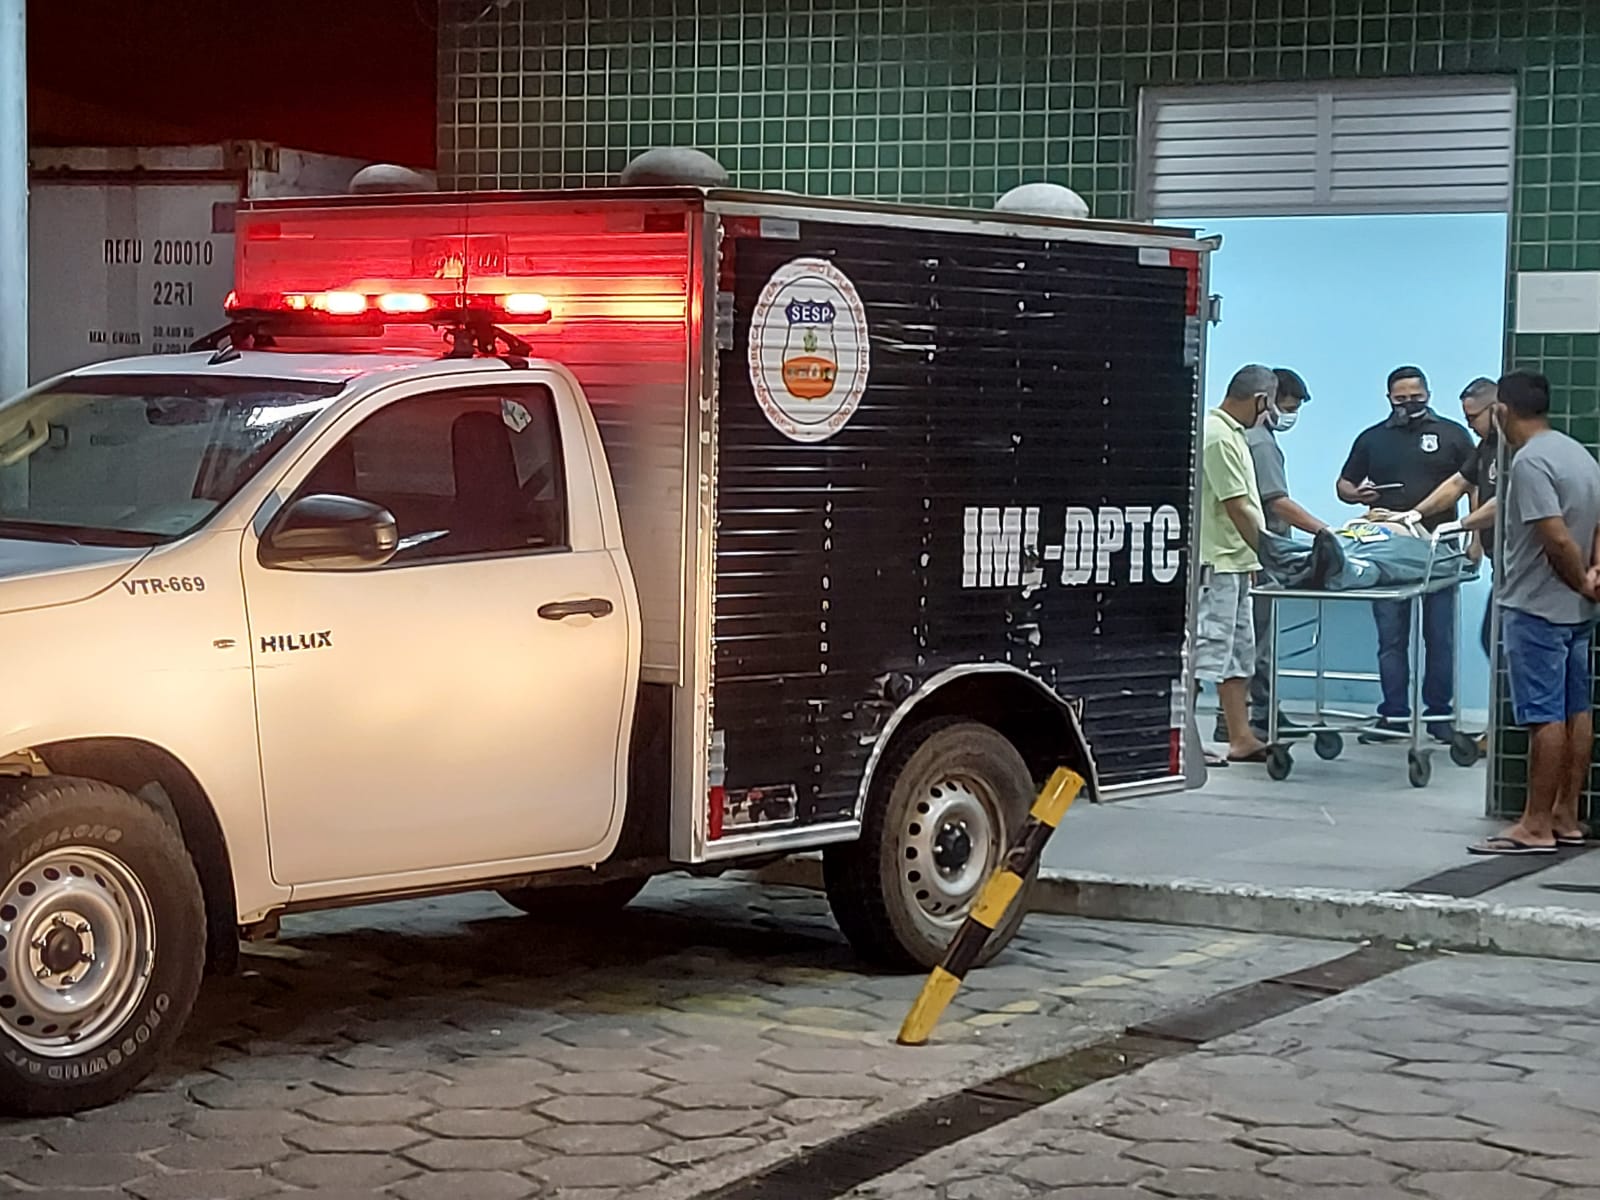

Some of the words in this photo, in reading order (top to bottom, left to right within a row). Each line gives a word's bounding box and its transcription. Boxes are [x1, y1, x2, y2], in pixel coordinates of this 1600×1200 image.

[104, 240, 142, 264] REFU
[154, 240, 213, 265] 200010
[153, 282, 193, 305] 22R1
[791, 306, 832, 322] SESP
[962, 505, 1181, 587] IML-DPTC
[122, 576, 206, 596] VTR-669
[260, 630, 333, 653] HILUX
